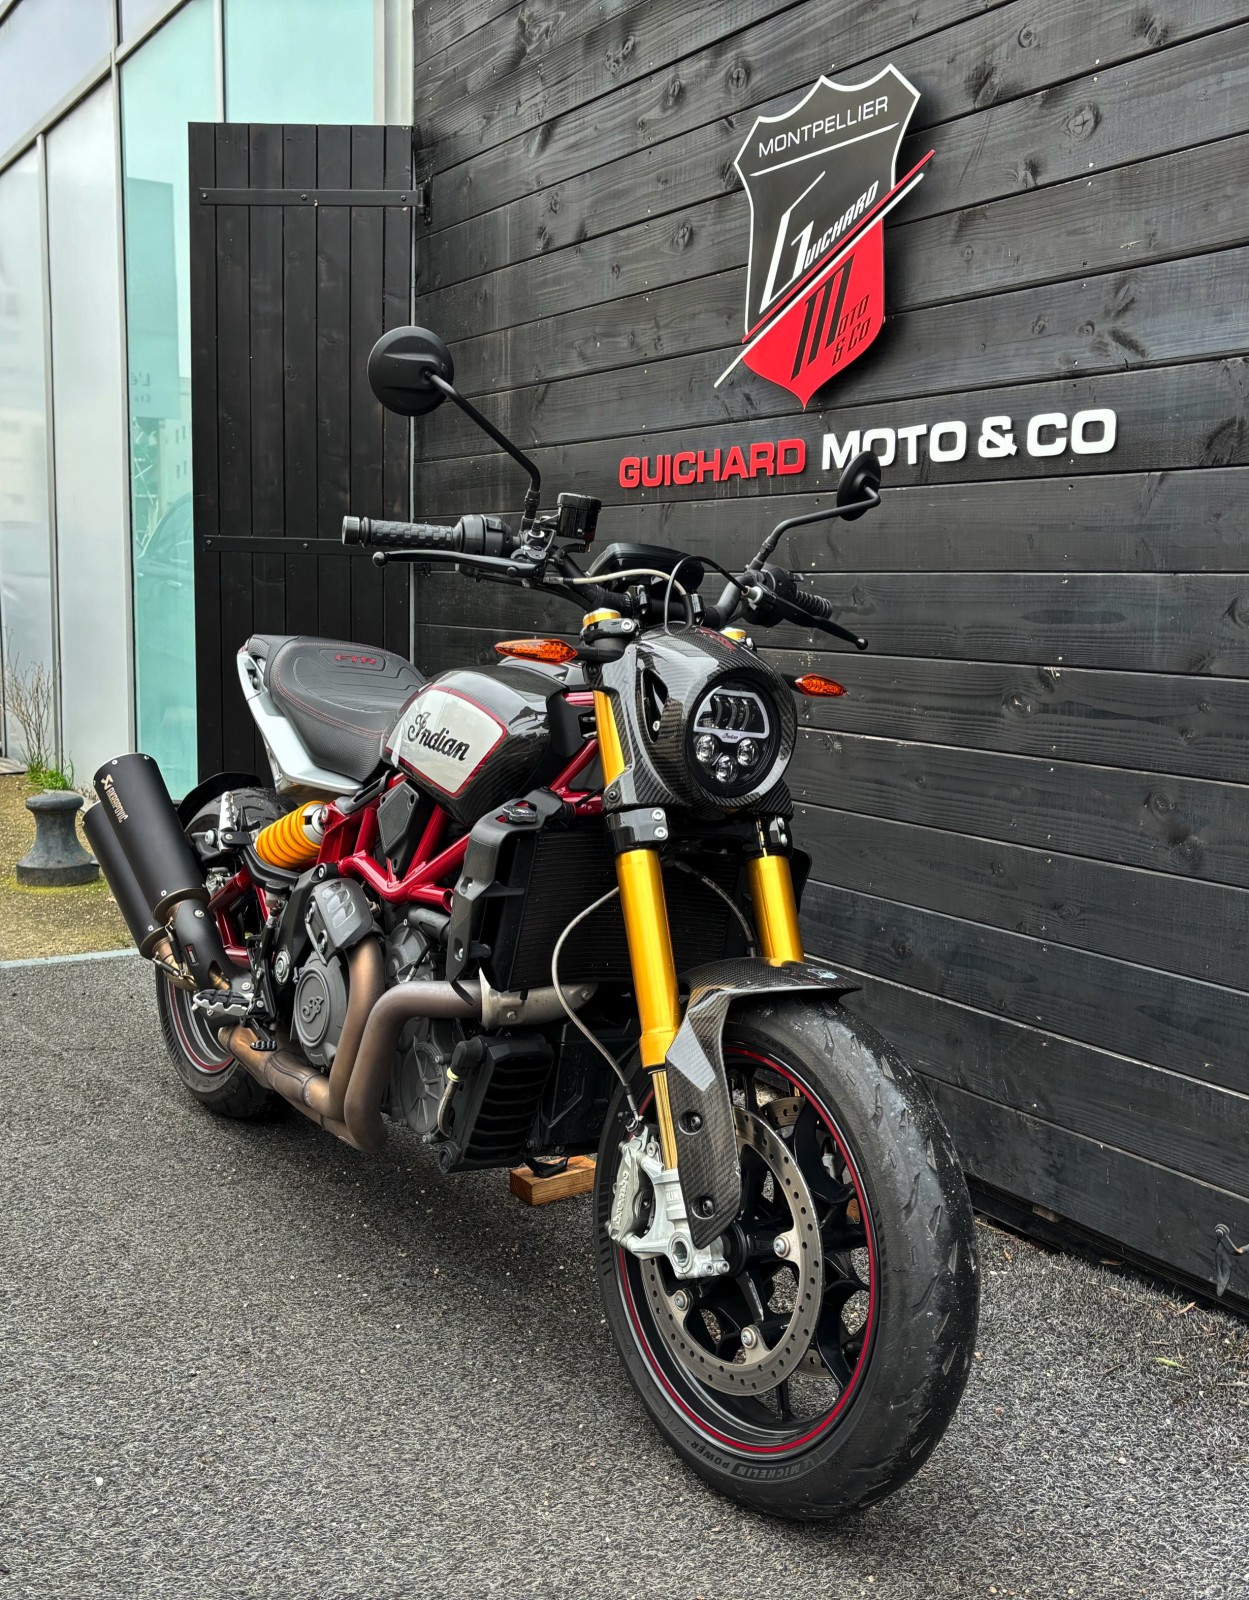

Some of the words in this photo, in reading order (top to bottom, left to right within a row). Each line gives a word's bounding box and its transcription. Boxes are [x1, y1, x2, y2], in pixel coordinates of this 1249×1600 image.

[758, 95, 889, 158] MONTPELLIER
[759, 170, 879, 315] GUICHARD
[619, 438, 806, 489] GUICHARD
[821, 420, 967, 471] MOTO
[978, 416, 1018, 458] &
[1026, 408, 1117, 457] CO
[407, 711, 470, 761] Indian
[690, 1440, 731, 1469] POWER
[737, 1462, 801, 1479] MICHELIN
